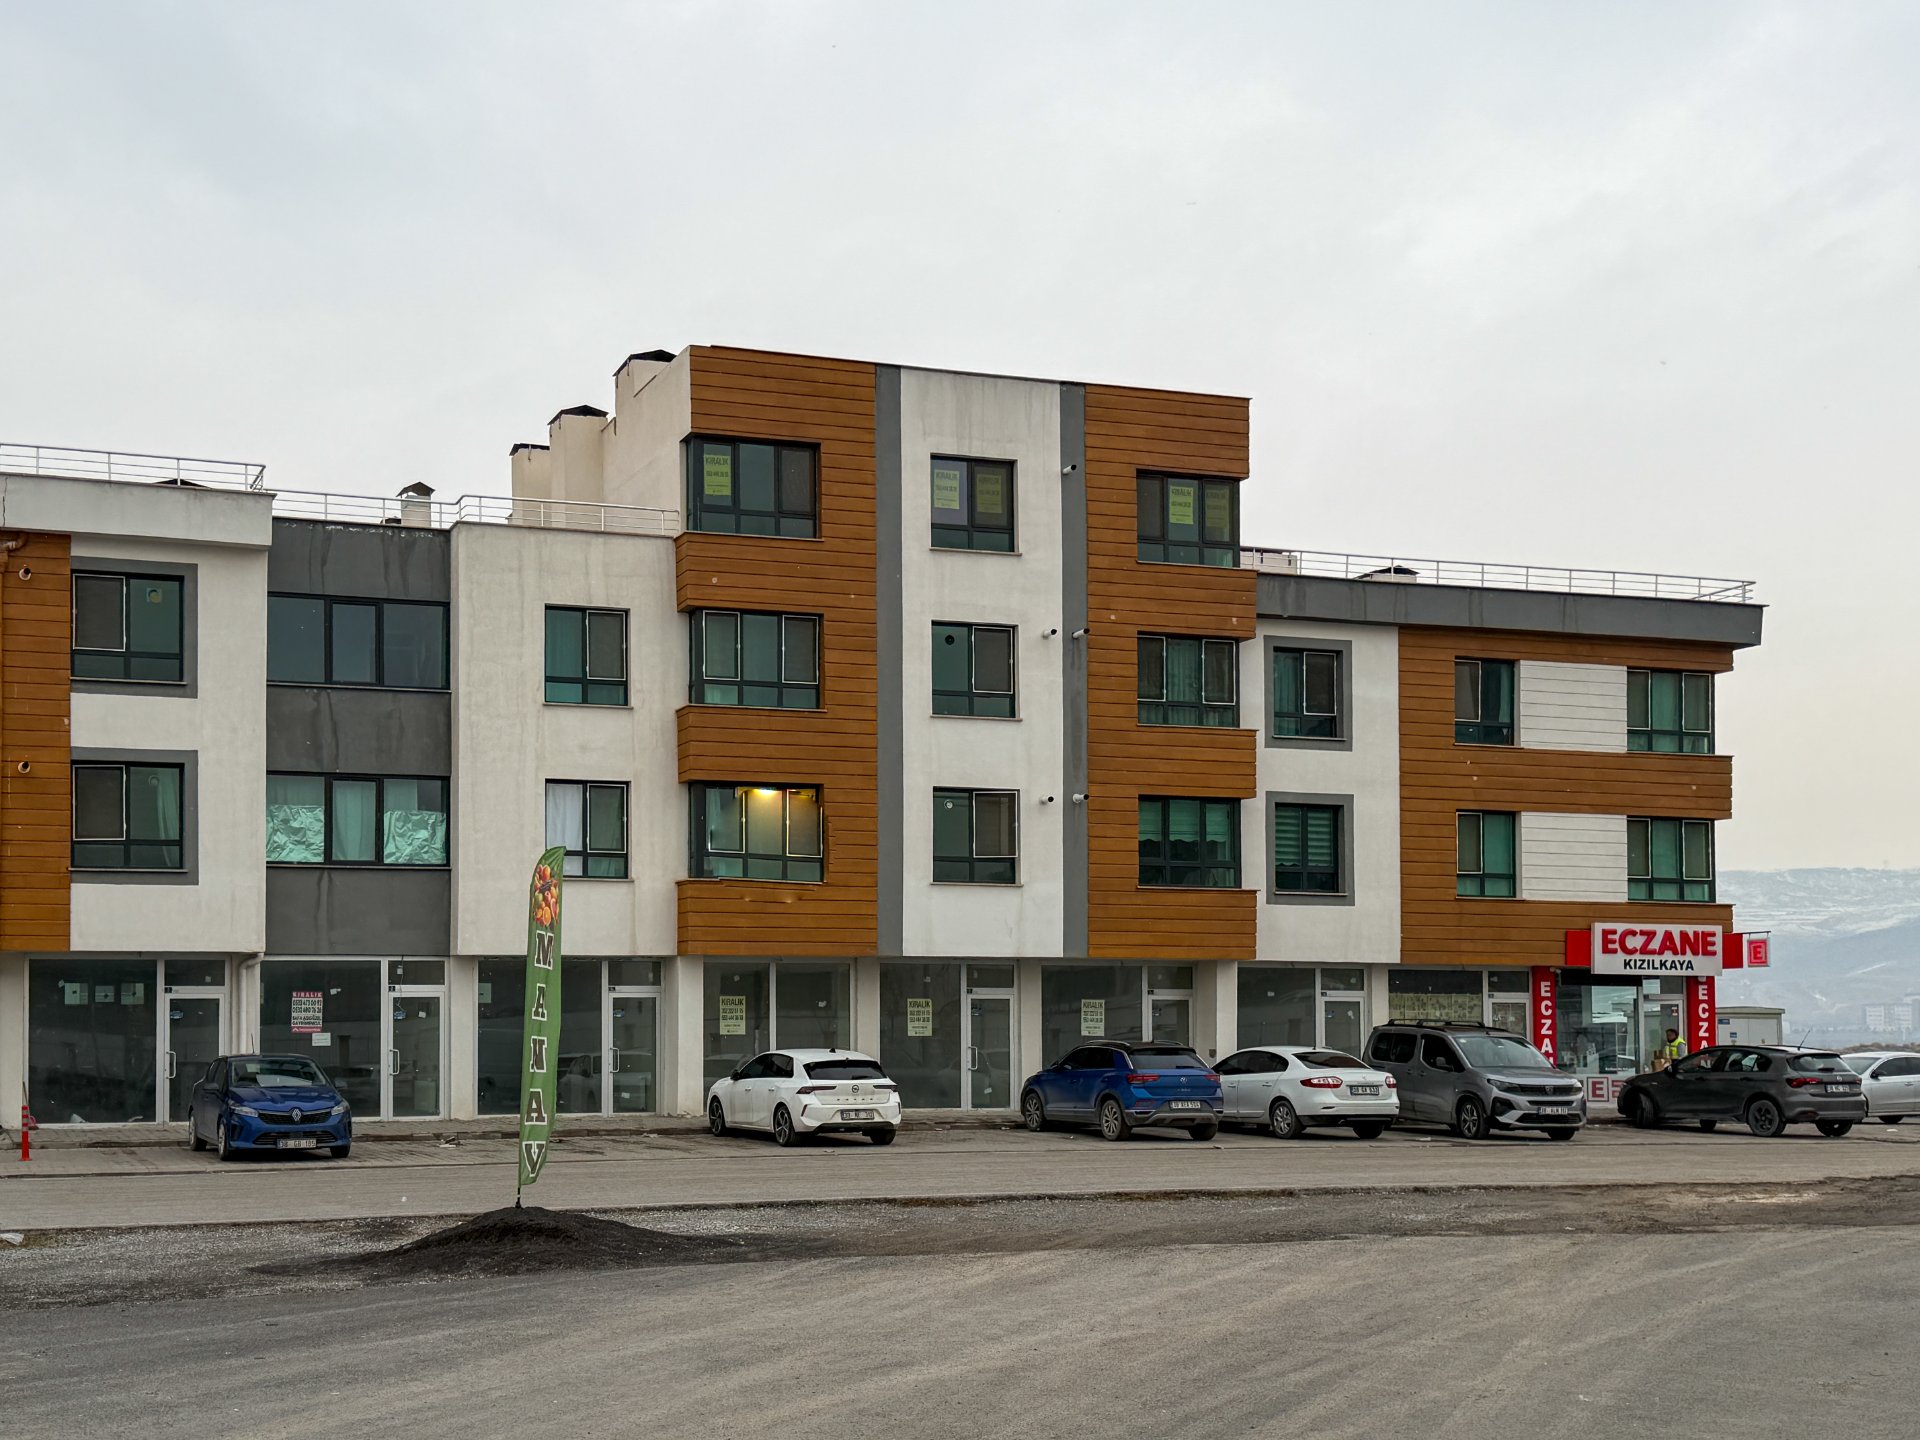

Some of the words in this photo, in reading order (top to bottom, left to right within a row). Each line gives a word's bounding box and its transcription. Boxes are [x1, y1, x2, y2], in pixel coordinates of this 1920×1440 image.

[1602, 928, 1717, 957] ECZANE
[1623, 959, 1694, 971] KIZILKAYA
[522, 930, 555, 1178] MANAV
